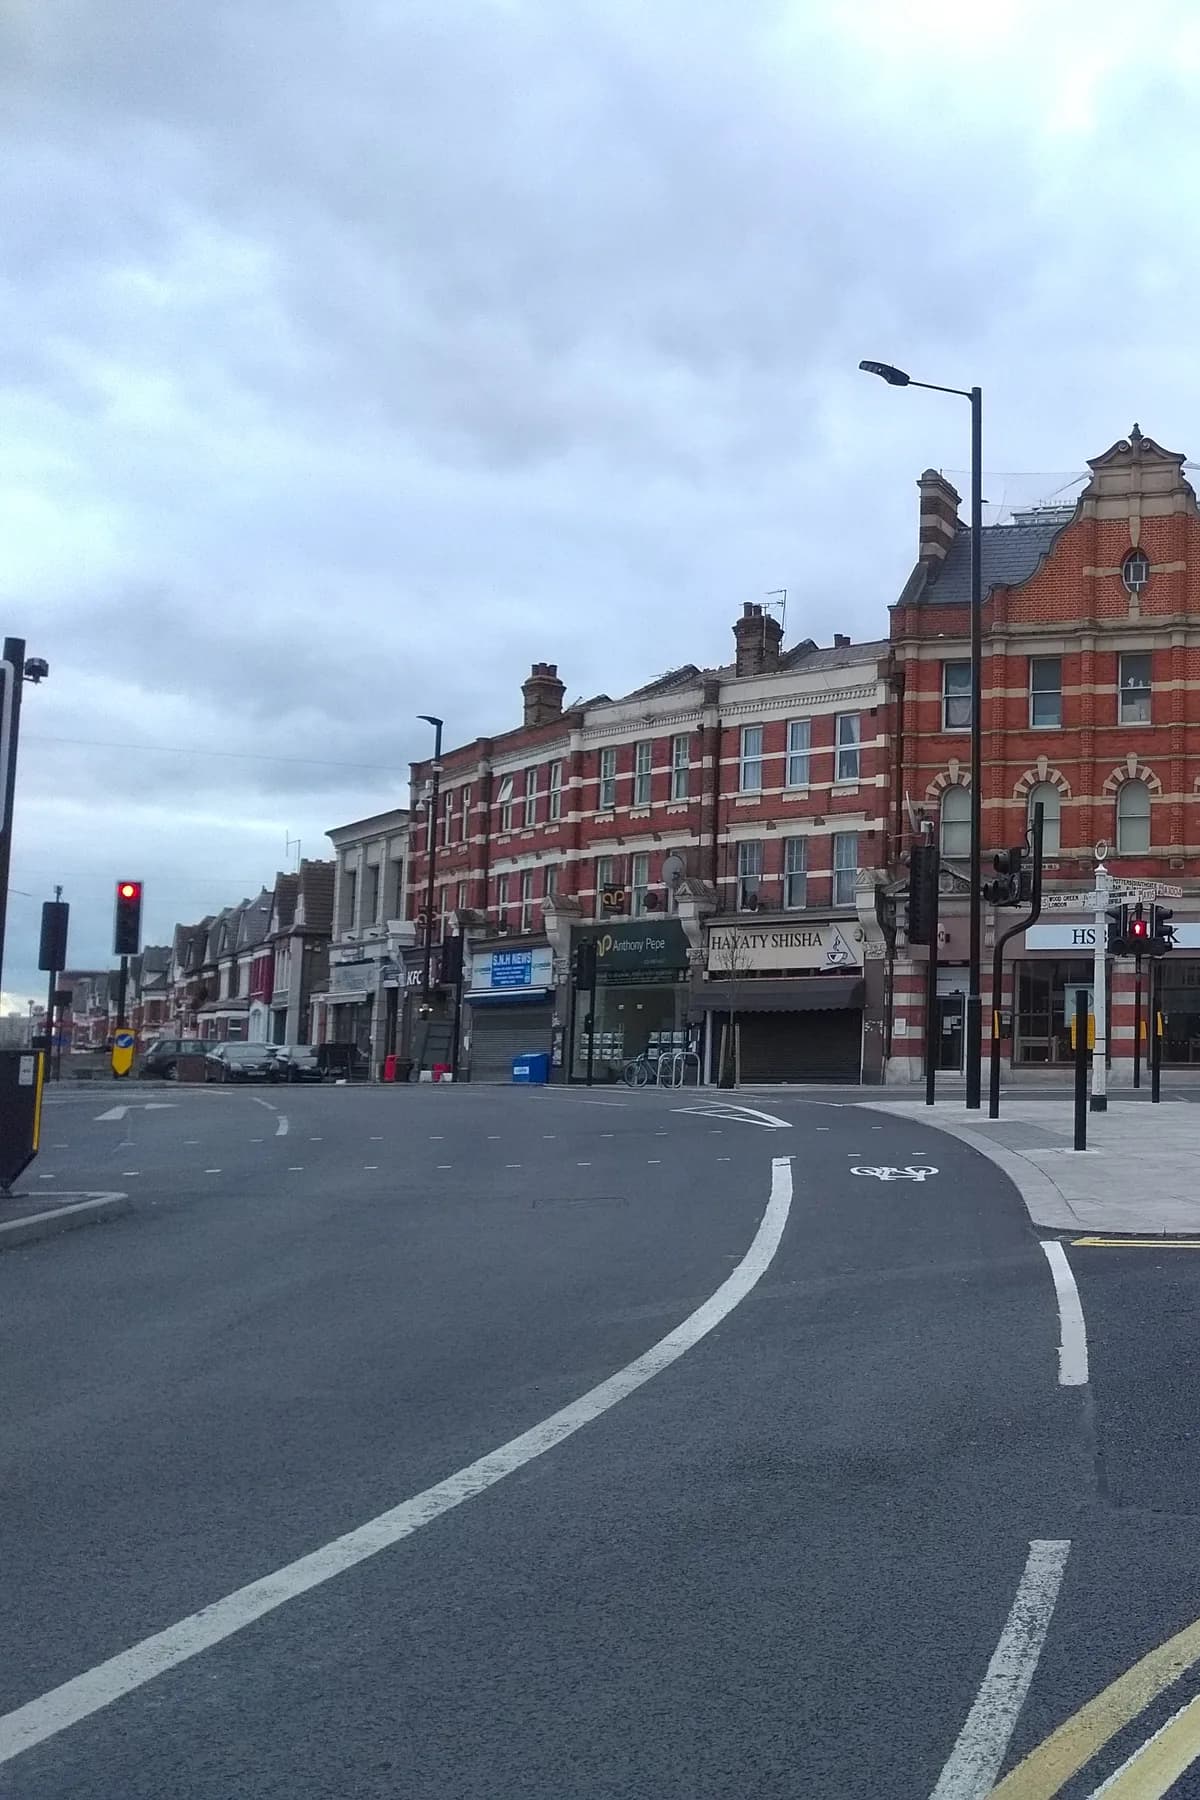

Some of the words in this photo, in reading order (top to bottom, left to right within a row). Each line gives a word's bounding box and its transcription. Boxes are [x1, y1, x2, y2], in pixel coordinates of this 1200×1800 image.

[613, 939, 644, 953] Anthony
[645, 938, 665, 951] Pepe
[711, 934, 769, 950] HAYATY
[771, 932, 822, 948] SHISHA
[511, 951, 531, 965] NEWS
[406, 970, 423, 986] KFC
